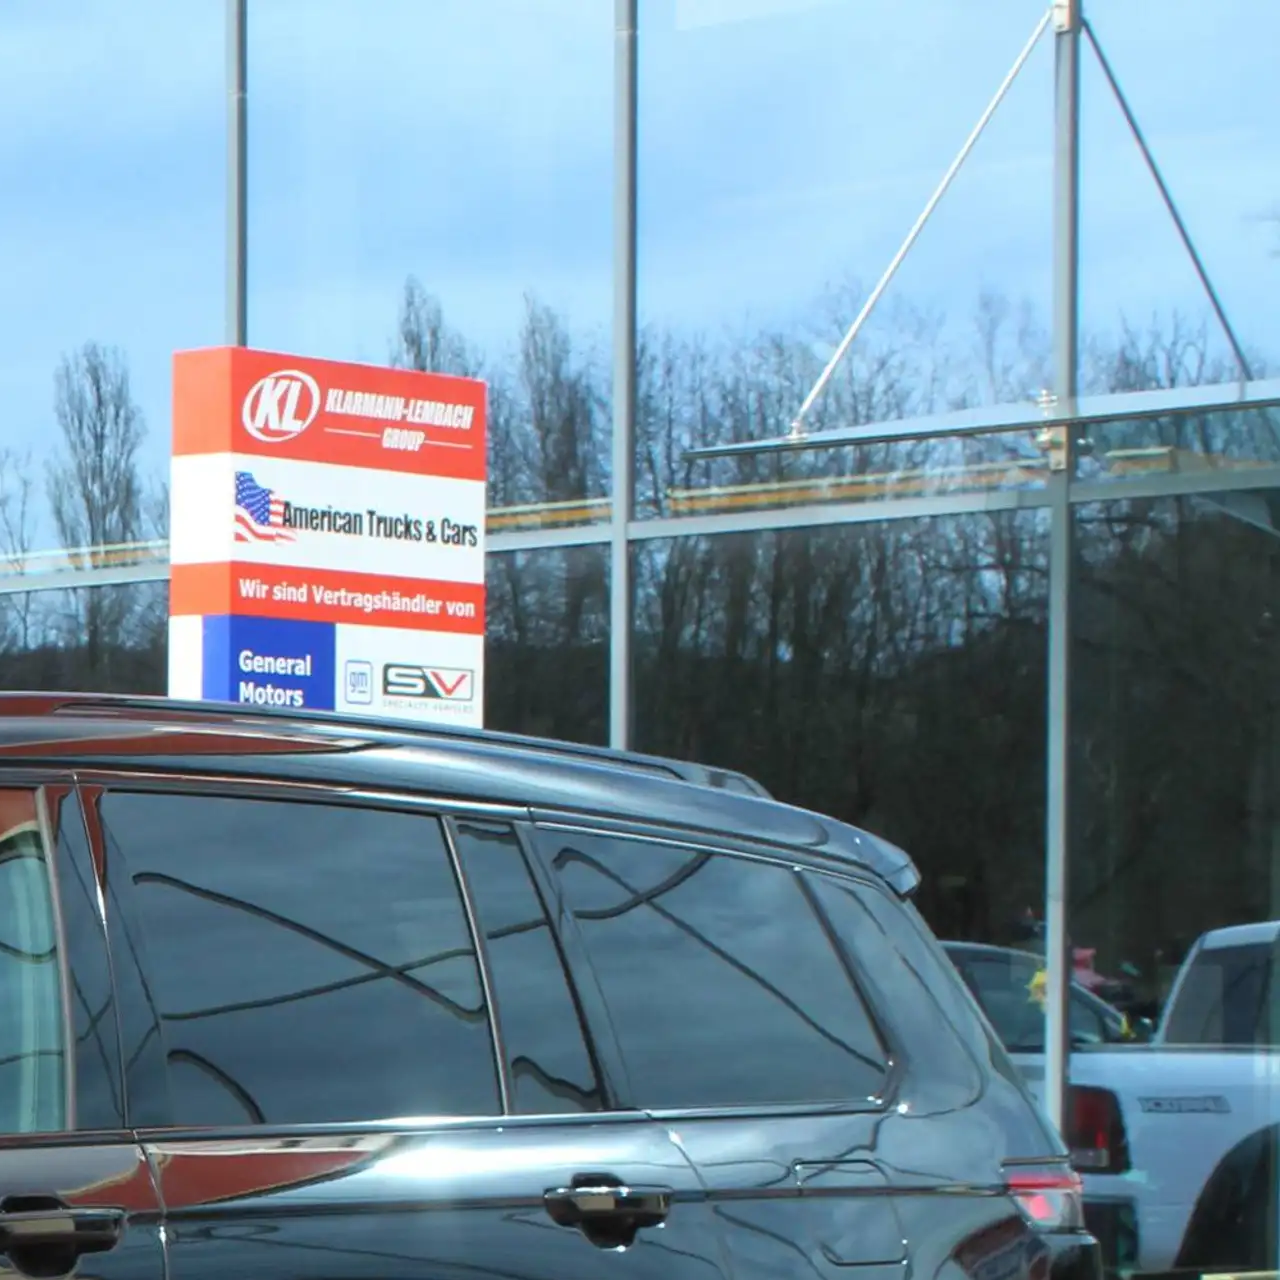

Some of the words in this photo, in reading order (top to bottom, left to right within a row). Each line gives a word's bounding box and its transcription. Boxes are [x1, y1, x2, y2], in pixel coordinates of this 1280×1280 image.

[254, 377, 304, 432] KL
[324, 388, 474, 429] KLARMANN-LEMBACH
[381, 427, 426, 451] GROUP
[282, 501, 363, 535] American
[366, 509, 422, 542] Trucks
[426, 521, 437, 542] &
[440, 518, 477, 547] Cars
[239, 578, 269, 598] Wir
[272, 581, 308, 602] sind
[311, 585, 443, 614] Vertragshändler
[446, 600, 475, 617] von
[238, 650, 311, 676] General
[239, 681, 304, 707] Motors
